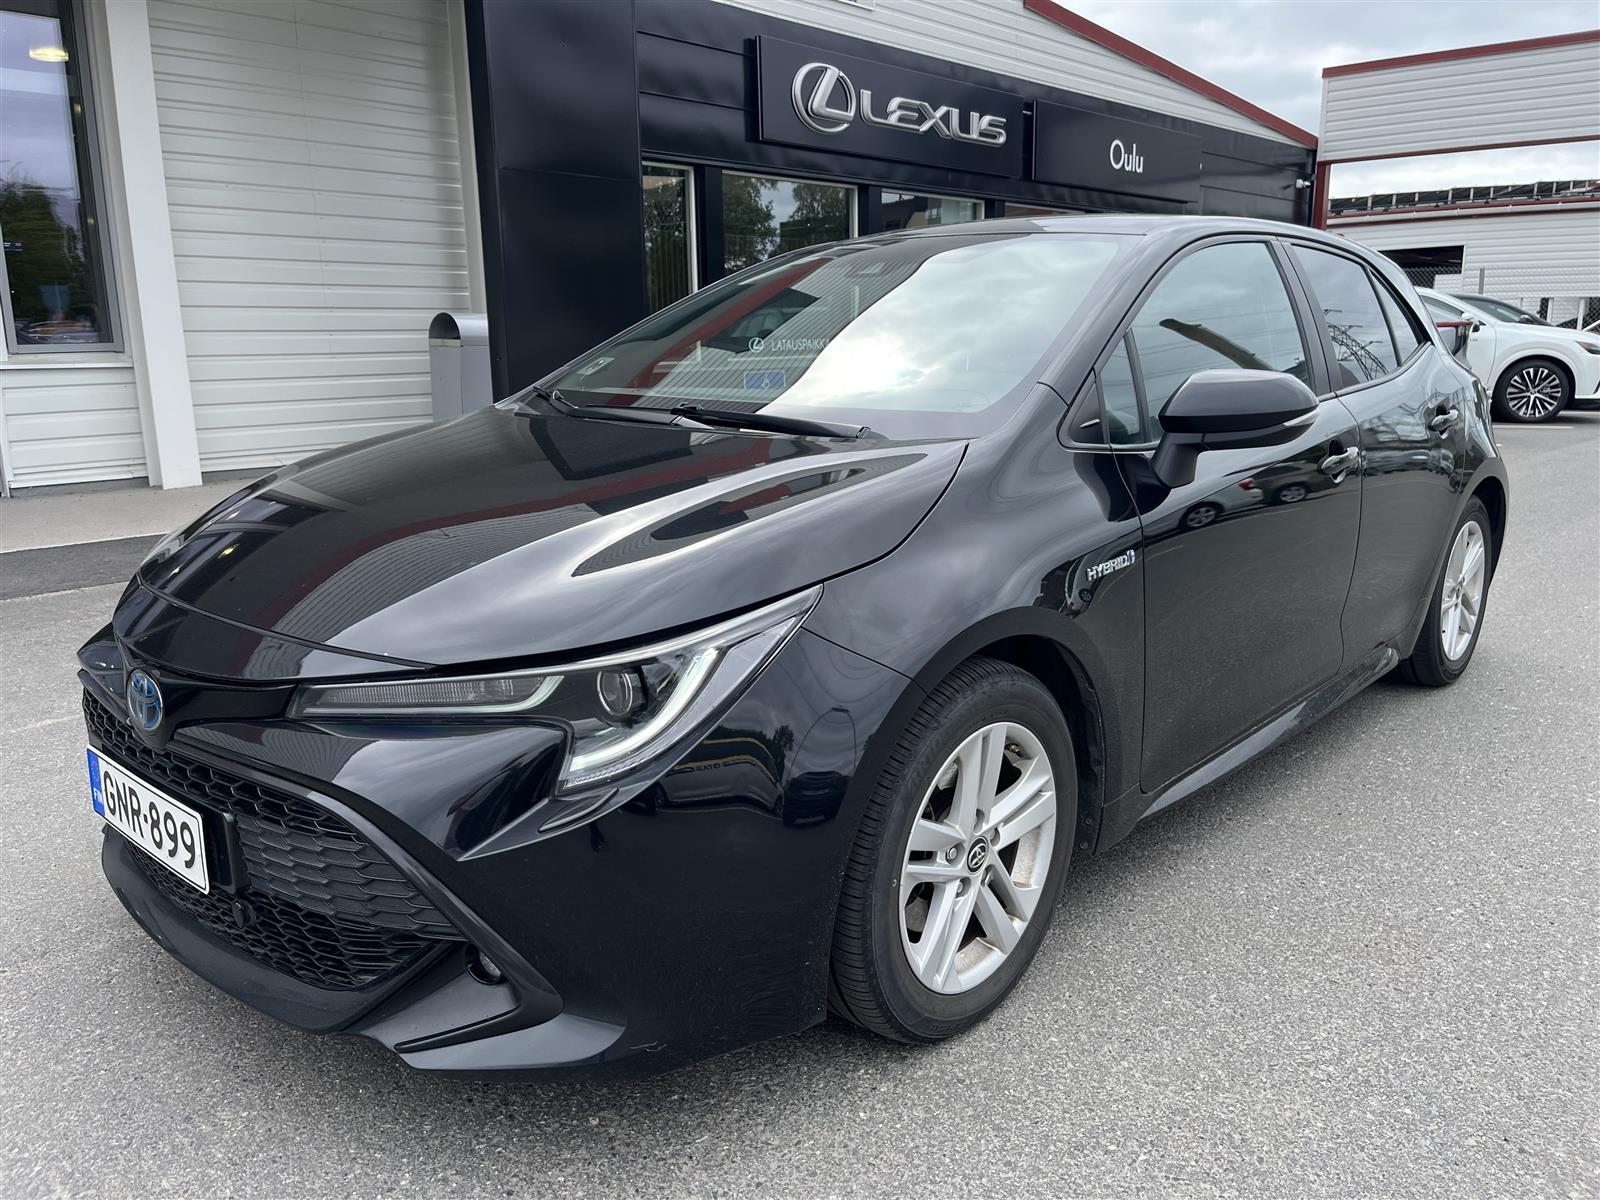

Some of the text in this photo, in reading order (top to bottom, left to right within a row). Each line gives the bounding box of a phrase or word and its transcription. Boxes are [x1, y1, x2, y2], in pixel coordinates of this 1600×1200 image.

[859, 89, 1008, 147] LEXUS
[1109, 138, 1144, 175] Oulu
[1087, 554, 1130, 582] HYBRID
[103, 771, 196, 869] GNR-899
